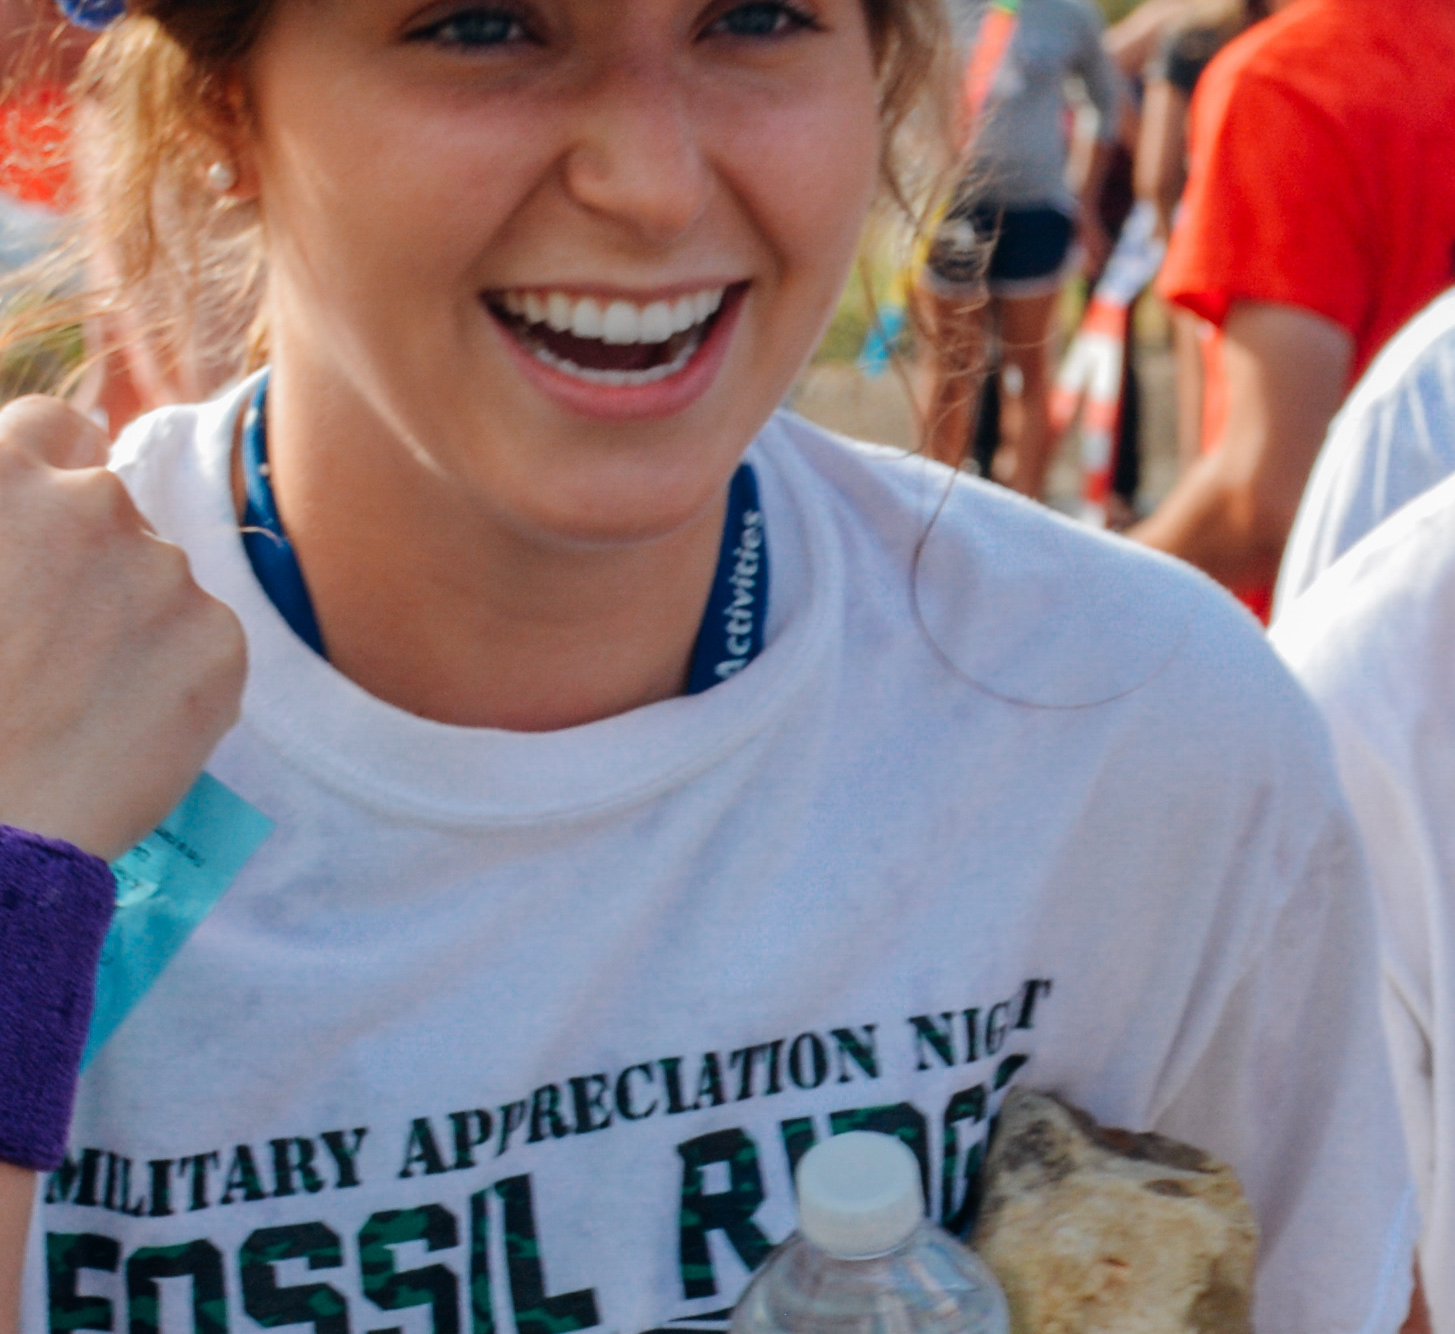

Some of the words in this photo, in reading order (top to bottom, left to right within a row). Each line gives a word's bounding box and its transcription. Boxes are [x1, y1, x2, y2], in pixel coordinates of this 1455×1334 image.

[714, 508, 763, 678] Activities
[46, 1127, 368, 1218] MILITARY
[397, 1024, 881, 1179] APPRECIATION
[908, 979, 1053, 1071] NIGT
